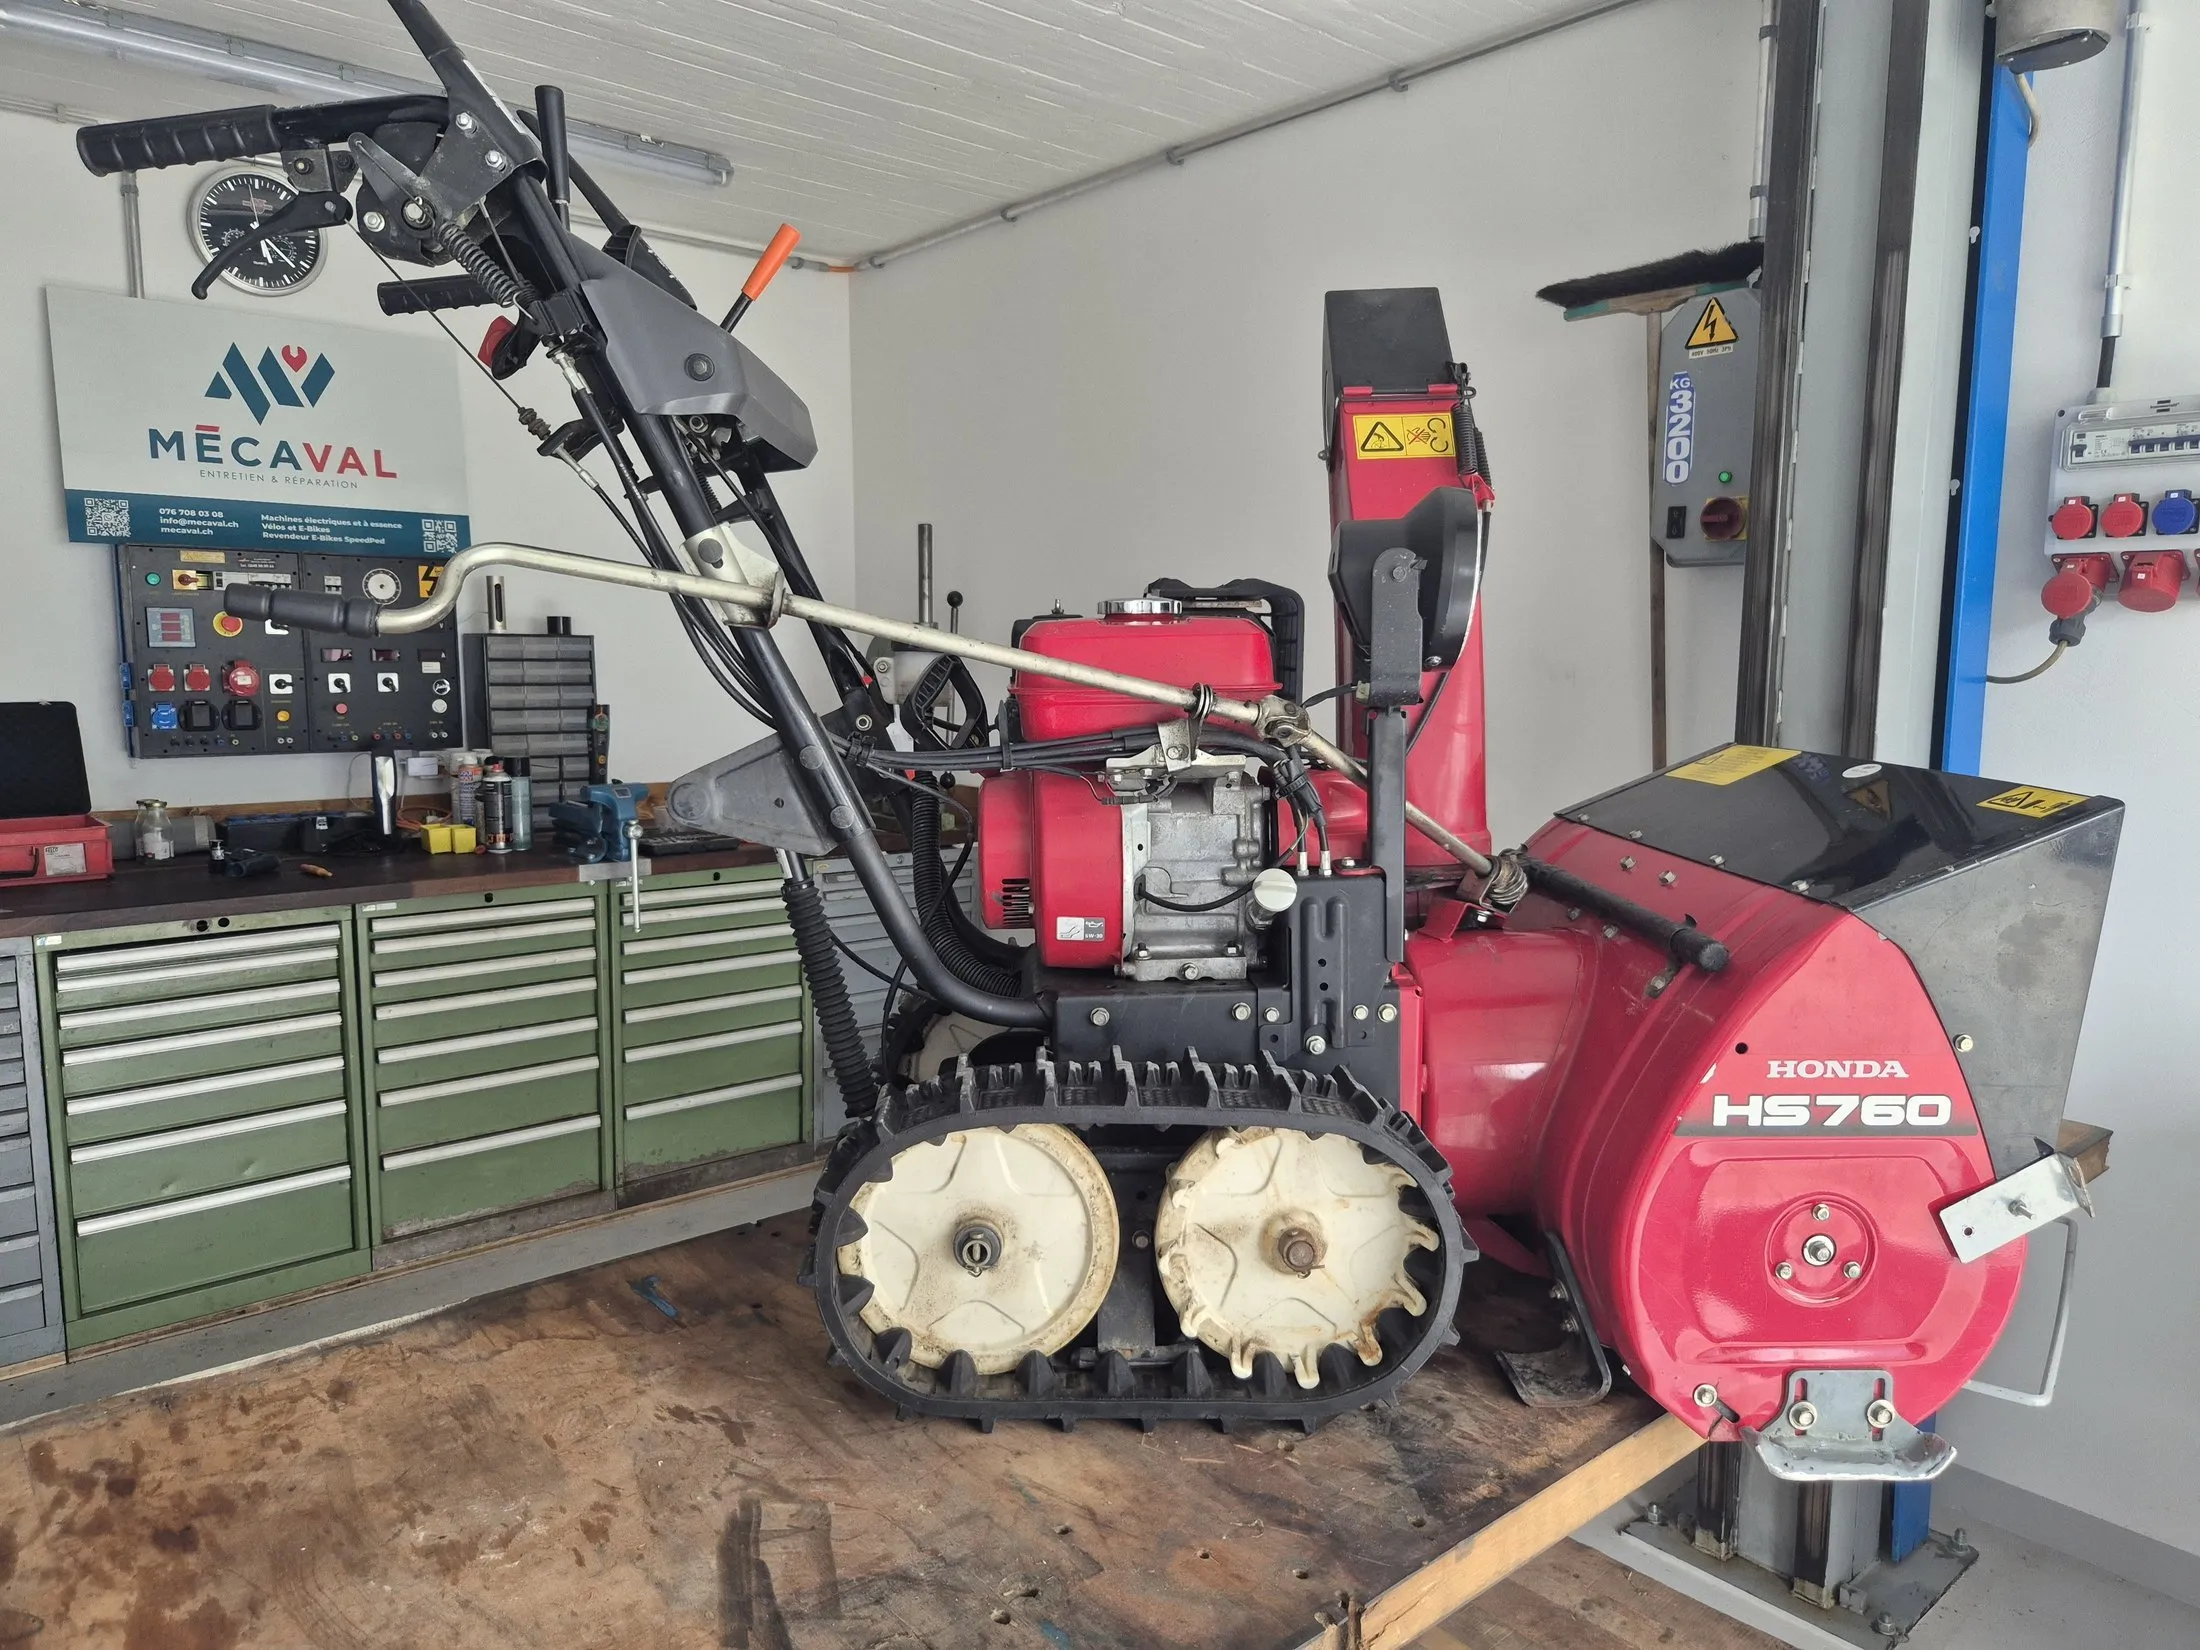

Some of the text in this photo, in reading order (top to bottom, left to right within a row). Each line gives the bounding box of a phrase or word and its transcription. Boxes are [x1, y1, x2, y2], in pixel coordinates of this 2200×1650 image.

[1669, 378, 1691, 390] KG
[1665, 390, 1693, 484] 3200
[199, 469, 359, 489] ENTRETIEN & RÉPARATION
[159, 508, 177, 516] 076
[178, 509, 196, 517] 708
[198, 510, 210, 518] 03
[160, 516, 239, 528] info@mecaval.ch
[261, 514, 303, 523] Machines
[304, 515, 351, 527] électriques
[363, 519, 369, 527] à
[370, 522, 403, 530] essence
[262, 523, 286, 531] Vélos
[299, 525, 331, 533] E-Bikes
[160, 526, 214, 536] mecaval.ch
[263, 532, 386, 545] Revendeur E-Bikes SpeedPed
[1766, 1060, 1909, 1078] HONDA
[1712, 1094, 1952, 1127] HS760
